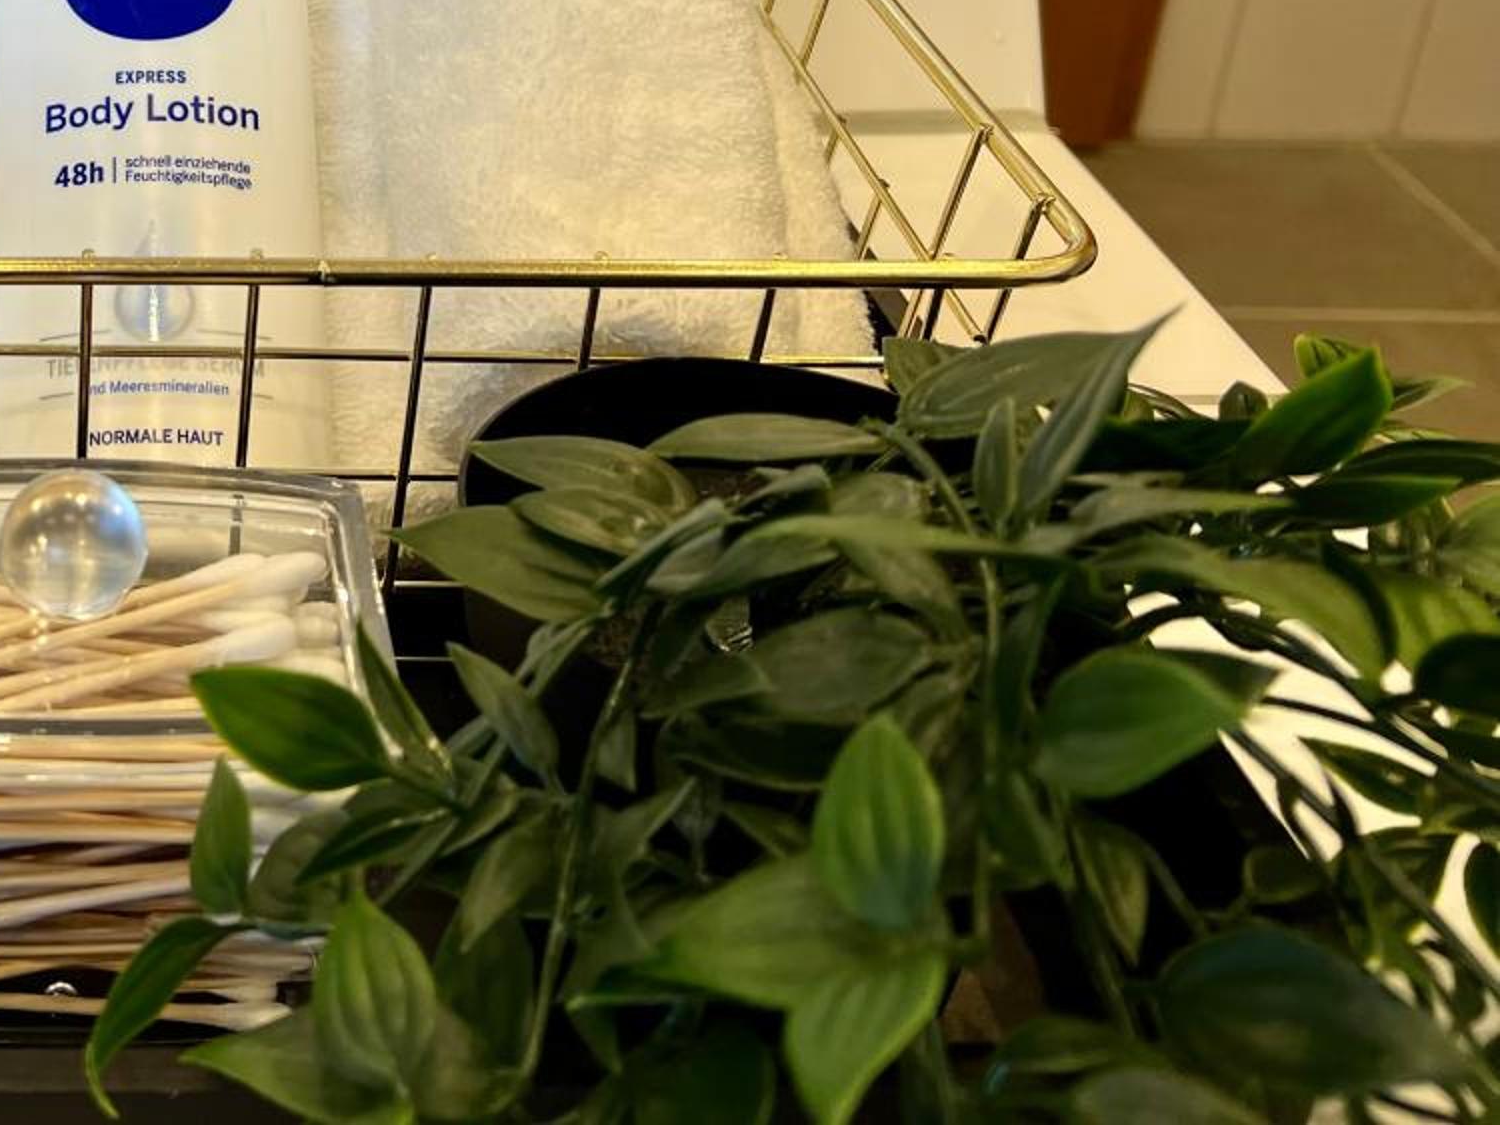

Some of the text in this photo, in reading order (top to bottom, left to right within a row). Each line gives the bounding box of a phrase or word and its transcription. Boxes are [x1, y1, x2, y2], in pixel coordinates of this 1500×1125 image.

[115, 70, 187, 85] EXPRESS
[45, 92, 260, 134] Body Lotion
[55, 161, 104, 188] 48h
[125, 156, 251, 175] schnell einziehende
[125, 170, 253, 190] Feuchtigkeitspflege
[109, 378, 229, 395] Meeresmineralien
[89, 429, 224, 447] NORMALE HAUT
